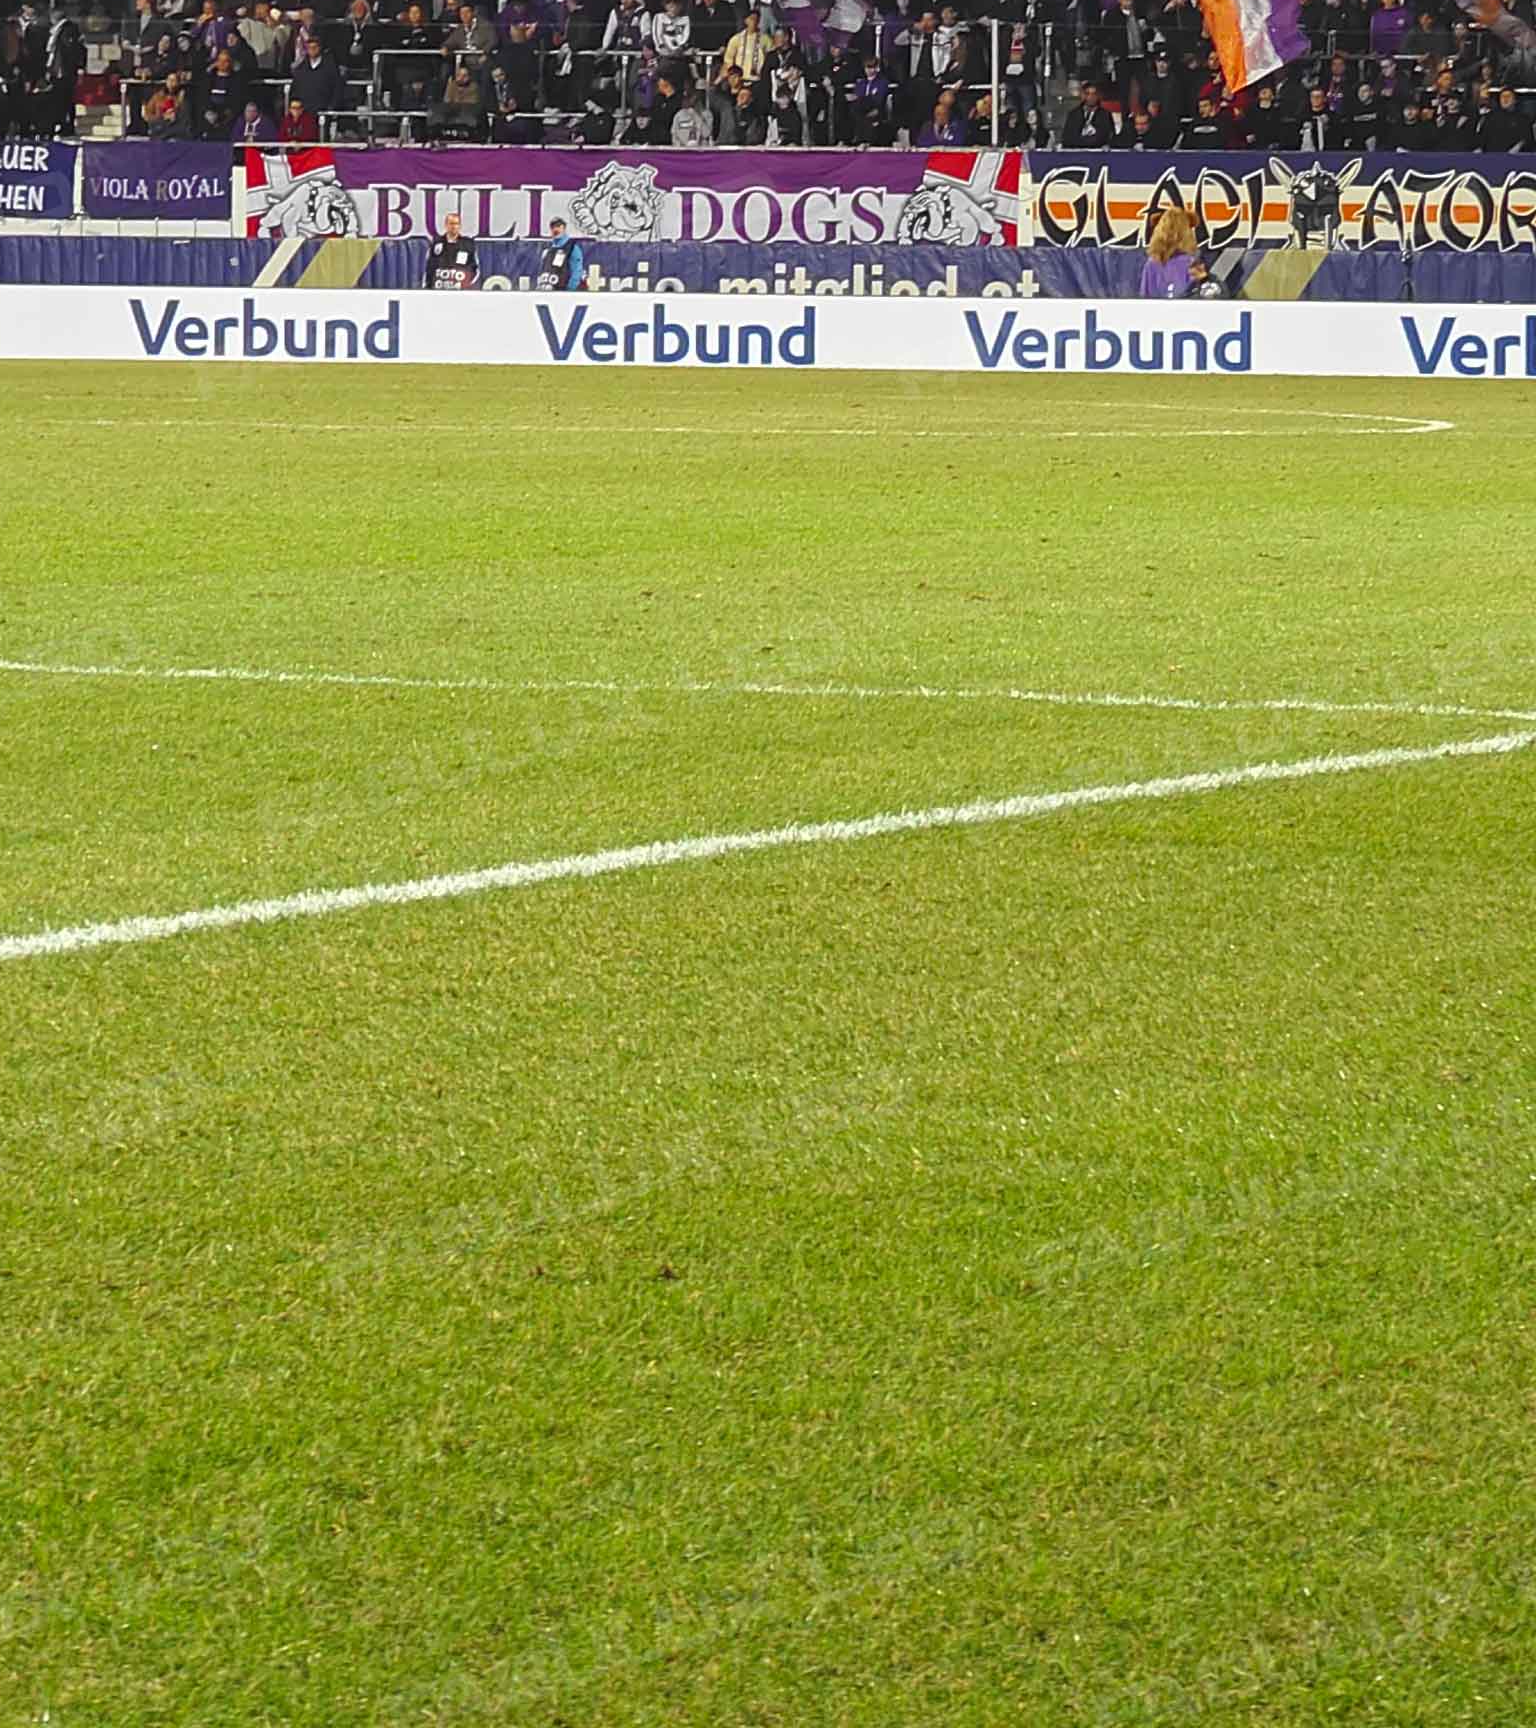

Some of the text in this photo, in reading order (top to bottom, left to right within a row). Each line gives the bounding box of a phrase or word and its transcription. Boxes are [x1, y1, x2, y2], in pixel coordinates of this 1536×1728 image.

[89, 174, 226, 202] VIOLA ROYAL
[368, 182, 888, 246] BULL DOGS
[128, 298, 401, 359] Verbund
[536, 303, 816, 365] Verbund
[963, 309, 1253, 372] Verbund
